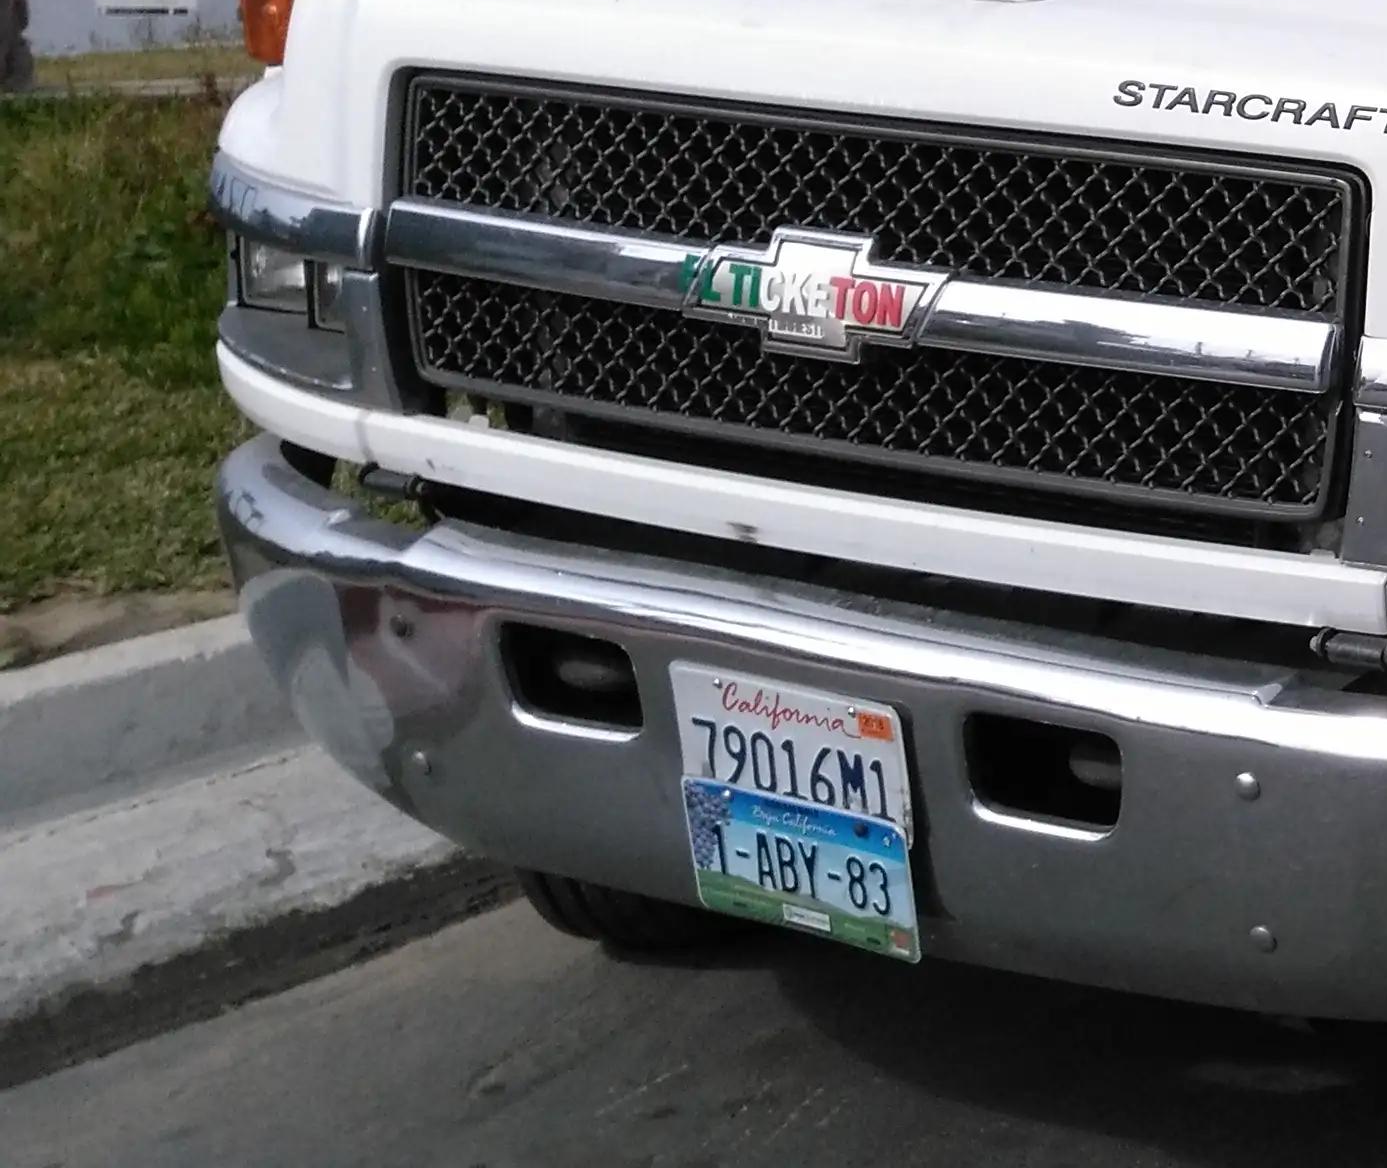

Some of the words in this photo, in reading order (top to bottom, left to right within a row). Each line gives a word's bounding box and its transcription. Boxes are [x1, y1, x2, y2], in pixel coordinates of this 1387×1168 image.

[677, 253, 721, 302] EL
[729, 263, 905, 329] TICKETON
[721, 681, 861, 739] California
[691, 716, 897, 823] 79016M1
